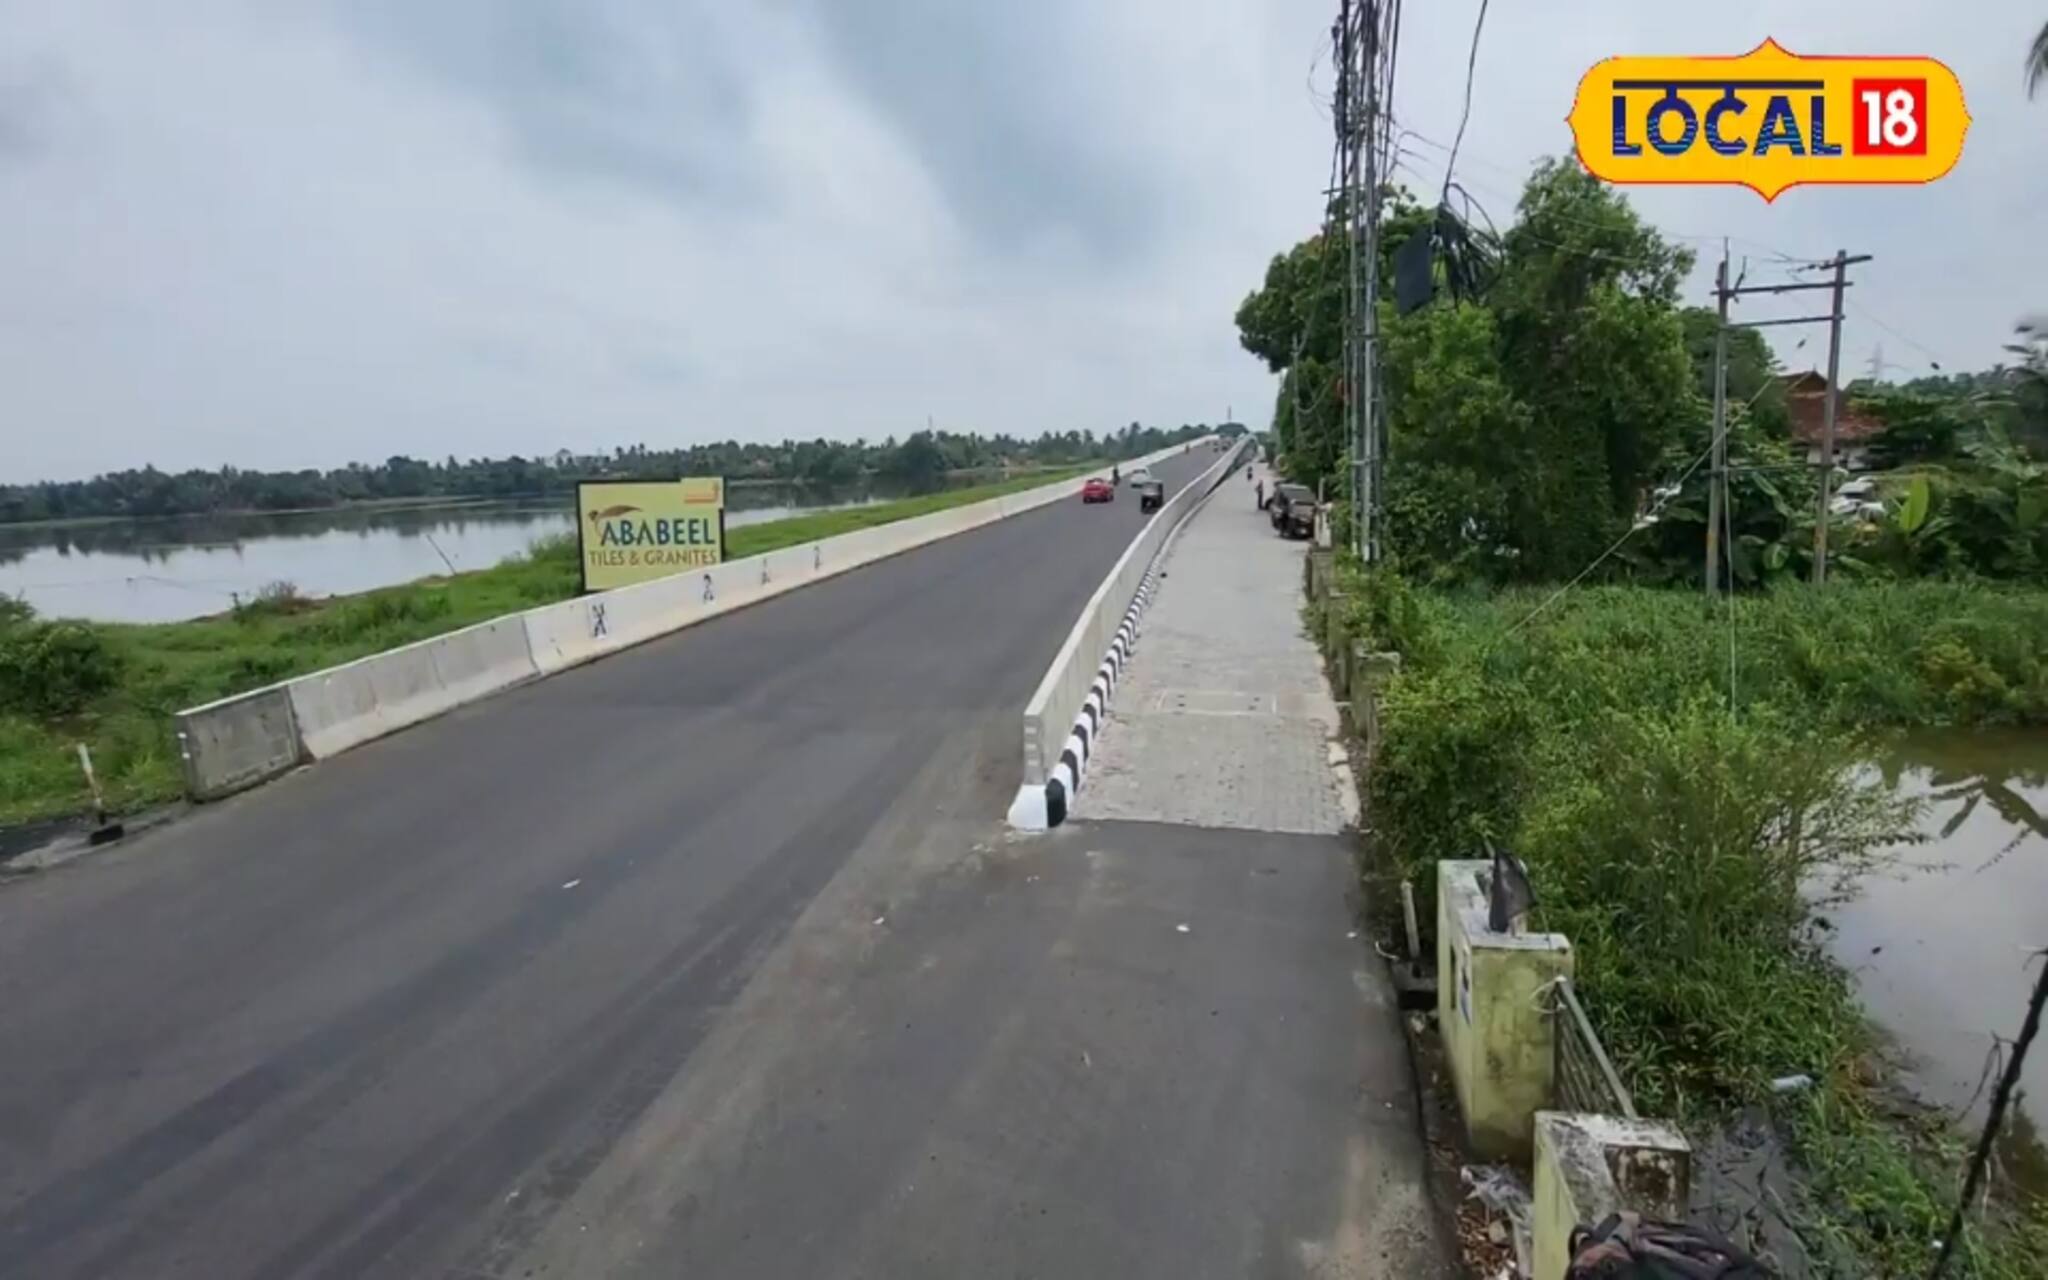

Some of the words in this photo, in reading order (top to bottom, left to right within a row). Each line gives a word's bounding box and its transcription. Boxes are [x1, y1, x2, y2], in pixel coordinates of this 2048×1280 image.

[601, 518, 716, 547] ABABEEL
[589, 551, 625, 566] TILES
[629, 551, 641, 566] &
[644, 549, 717, 566] GRANITES
